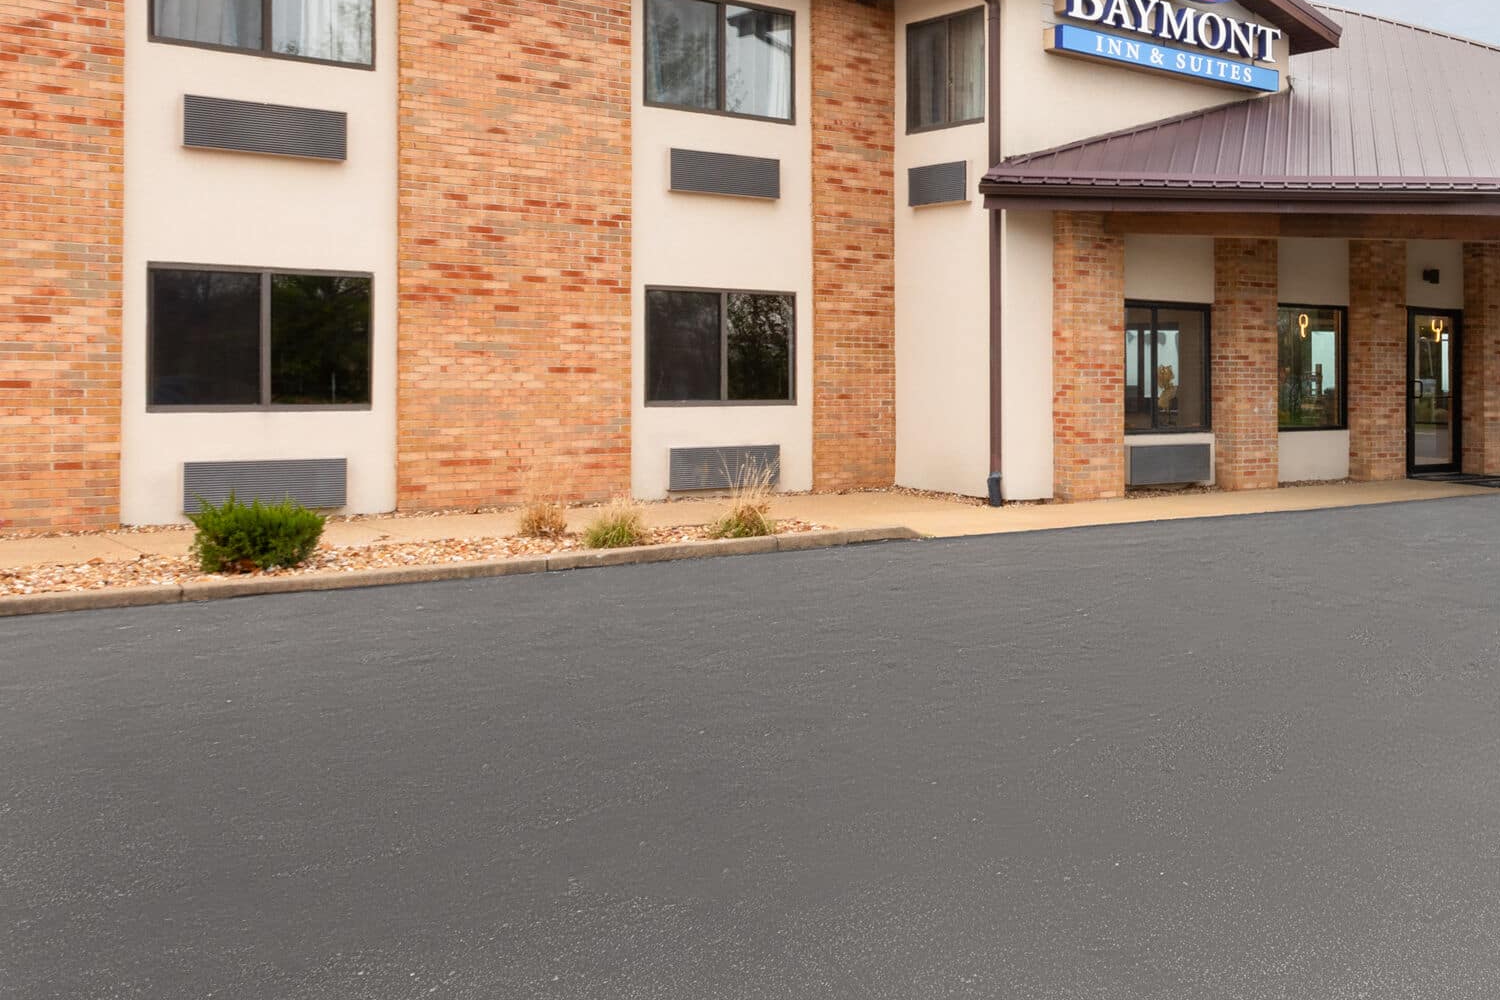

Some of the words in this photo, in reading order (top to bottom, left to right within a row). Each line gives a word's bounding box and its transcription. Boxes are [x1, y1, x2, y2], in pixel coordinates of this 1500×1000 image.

[1095, 34, 1140, 60] INN
[1150, 47, 1164, 66] &
[1175, 52, 1253, 84] SUITES
